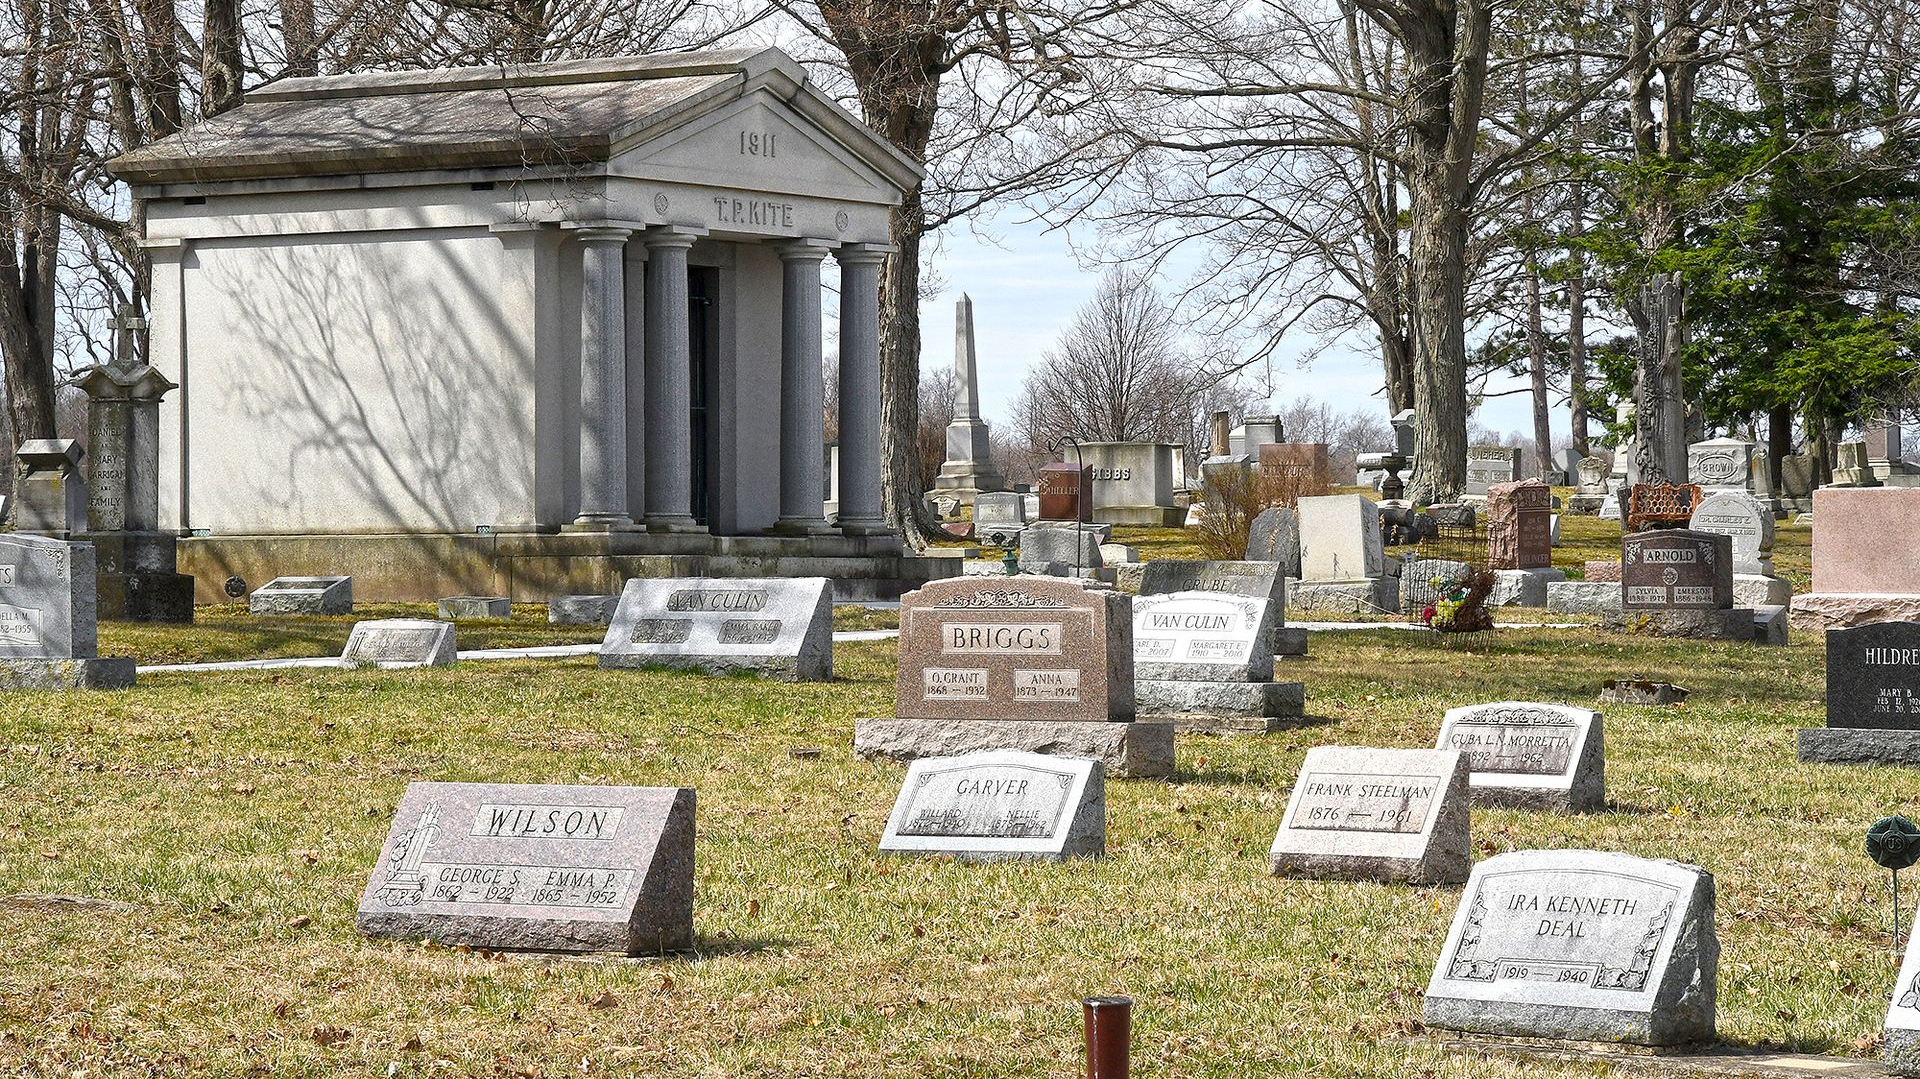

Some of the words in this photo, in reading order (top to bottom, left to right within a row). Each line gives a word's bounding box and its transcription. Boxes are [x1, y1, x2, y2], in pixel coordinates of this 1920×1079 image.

[740, 131, 776, 158] 1911
[1701, 463, 1734, 473] BROWN
[90, 497, 121, 507] FAMILY
[1646, 550, 1694, 562] ARNOLD
[1182, 578, 1230, 592] GRUBE
[1636, 587, 1659, 596] SYLVIA
[1676, 587, 1711, 597] EMERSON
[674, 593, 708, 609] VAN
[711, 593, 764, 609] CULIN
[0, 613, 19, 621] ELLA
[1153, 614, 1181, 628] VAN
[1185, 615, 1230, 629] CULIN
[953, 628, 1051, 649] BRIGGS
[1148, 648, 1169, 656] 2007
[1192, 642, 1233, 650] MARGARET
[1224, 650, 1244, 658] 2010
[1031, 674, 1062, 685] ANNA
[927, 686, 948, 696] 1868
[965, 686, 986, 696] 1932
[1016, 687, 1037, 696] 1873
[1055, 687, 1077, 697] 1947
[1879, 688, 1902, 697] MARY
[1874, 705, 1890, 713] JUNE
[1452, 733, 1481, 746] CUBA
[1520, 753, 1544, 764] 1962
[957, 779, 1029, 796] GARVER
[1307, 783, 1353, 797] FRANK
[1358, 784, 1432, 799] STEELMAN
[920, 809, 962, 819] WILLARD
[1006, 810, 1040, 820] NELLIE
[1308, 807, 1341, 820] 1876
[1379, 811, 1412, 823] 1961
[489, 808, 609, 839] WILSON
[439, 868, 504, 885] GEORGE
[546, 871, 596, 888] EMMA
[602, 873, 614, 890] P.
[431, 885, 463, 900] 1862
[484, 887, 516, 902] 1922
[532, 889, 564, 904] 1865
[1508, 894, 1540, 912] IRA
[1546, 895, 1637, 917] KENNETH
[1536, 919, 1586, 939] DEAL
[1503, 966, 1529, 980] 1919
[1557, 969, 1590, 983] 1940
